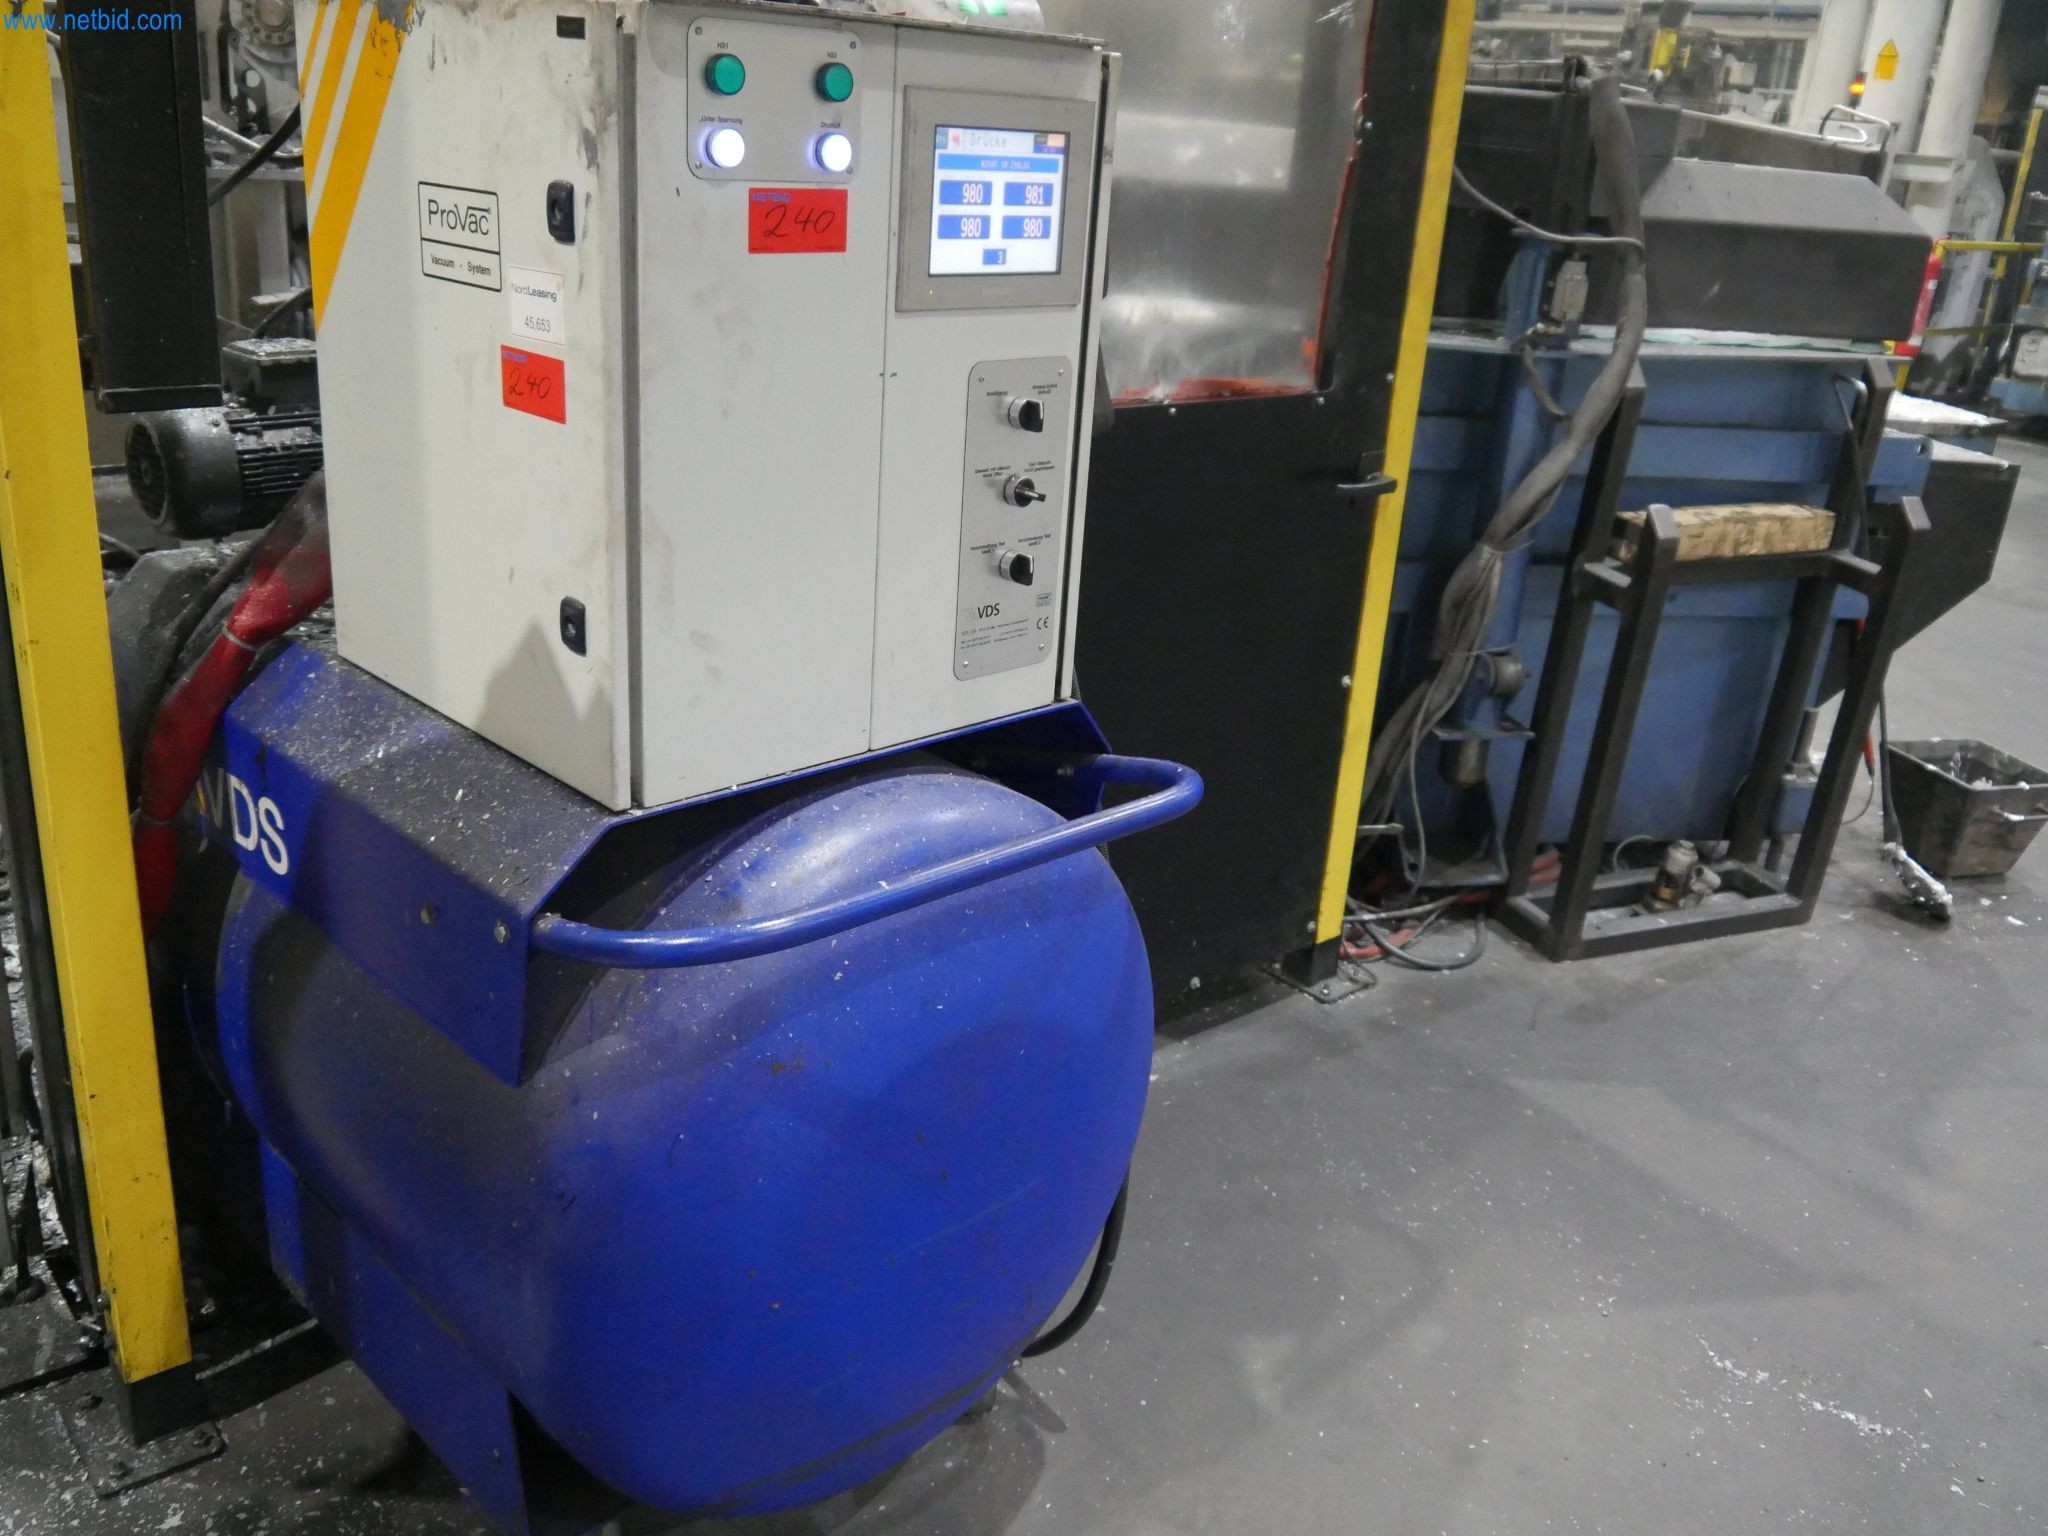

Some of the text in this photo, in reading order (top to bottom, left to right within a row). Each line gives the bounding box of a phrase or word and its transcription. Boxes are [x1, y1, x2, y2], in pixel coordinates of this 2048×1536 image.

[962, 183, 983, 204] 980
[1025, 185, 1044, 205] 981
[763, 204, 836, 238] 240
[960, 217, 981, 238] 980
[1023, 218, 1042, 238] 980
[430, 253, 456, 269] Vacuum
[467, 260, 492, 277] System
[511, 282, 558, 303] NordLeasing
[524, 315, 551, 334] 45.653
[508, 368, 551, 400] 240
[977, 603, 1000, 619] VDS
